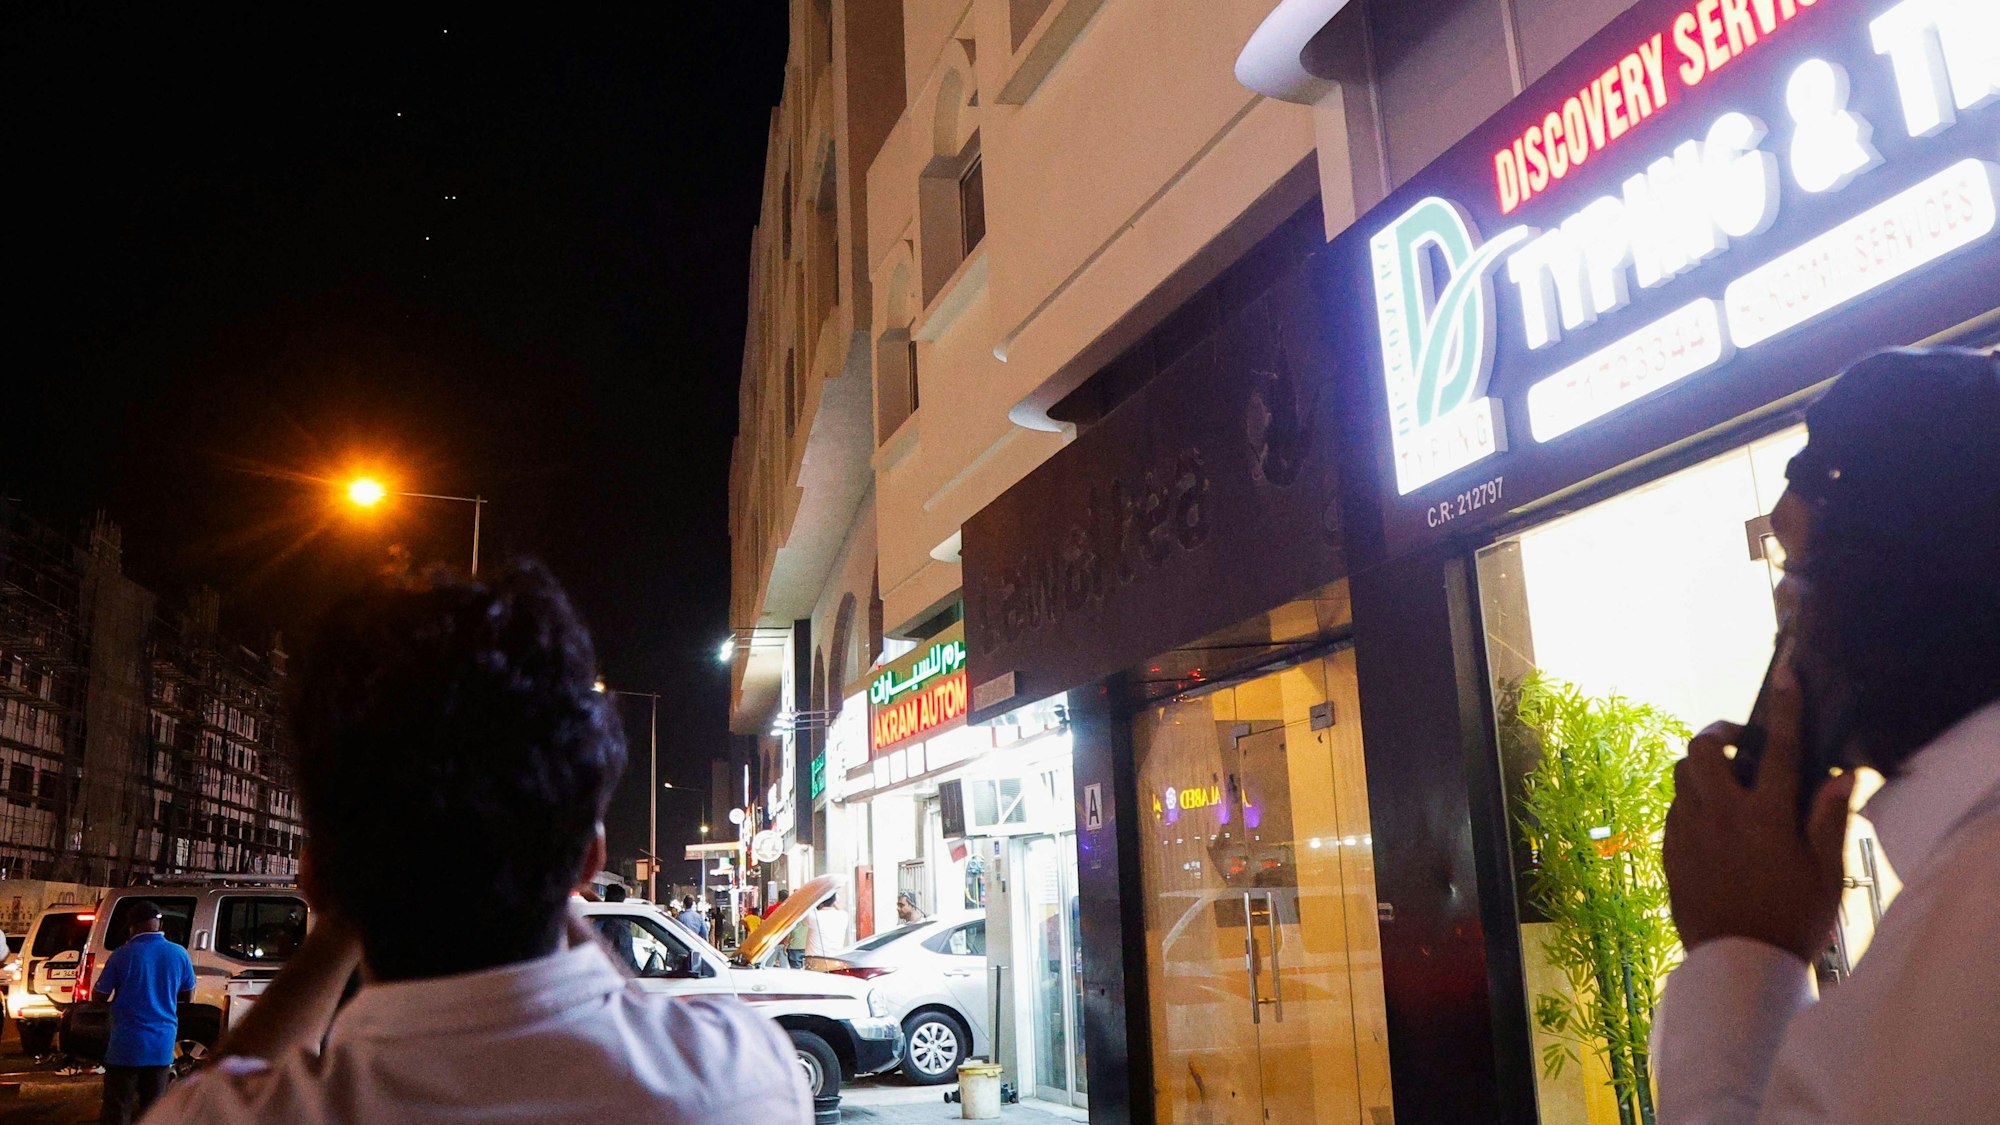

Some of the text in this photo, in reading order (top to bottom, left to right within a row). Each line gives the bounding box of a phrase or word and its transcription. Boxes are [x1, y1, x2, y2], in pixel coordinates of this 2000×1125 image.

[1495, 31, 1669, 214] DISCOVERY
[1508, 112, 1771, 351] TYPING
[1786, 58, 1875, 193] &
[1852, 178, 1975, 276] SERVICES
[1427, 476, 1504, 528] C.R: 212797
[873, 673, 967, 749] AKRAM AUTOM
[1088, 788, 1100, 826] A
